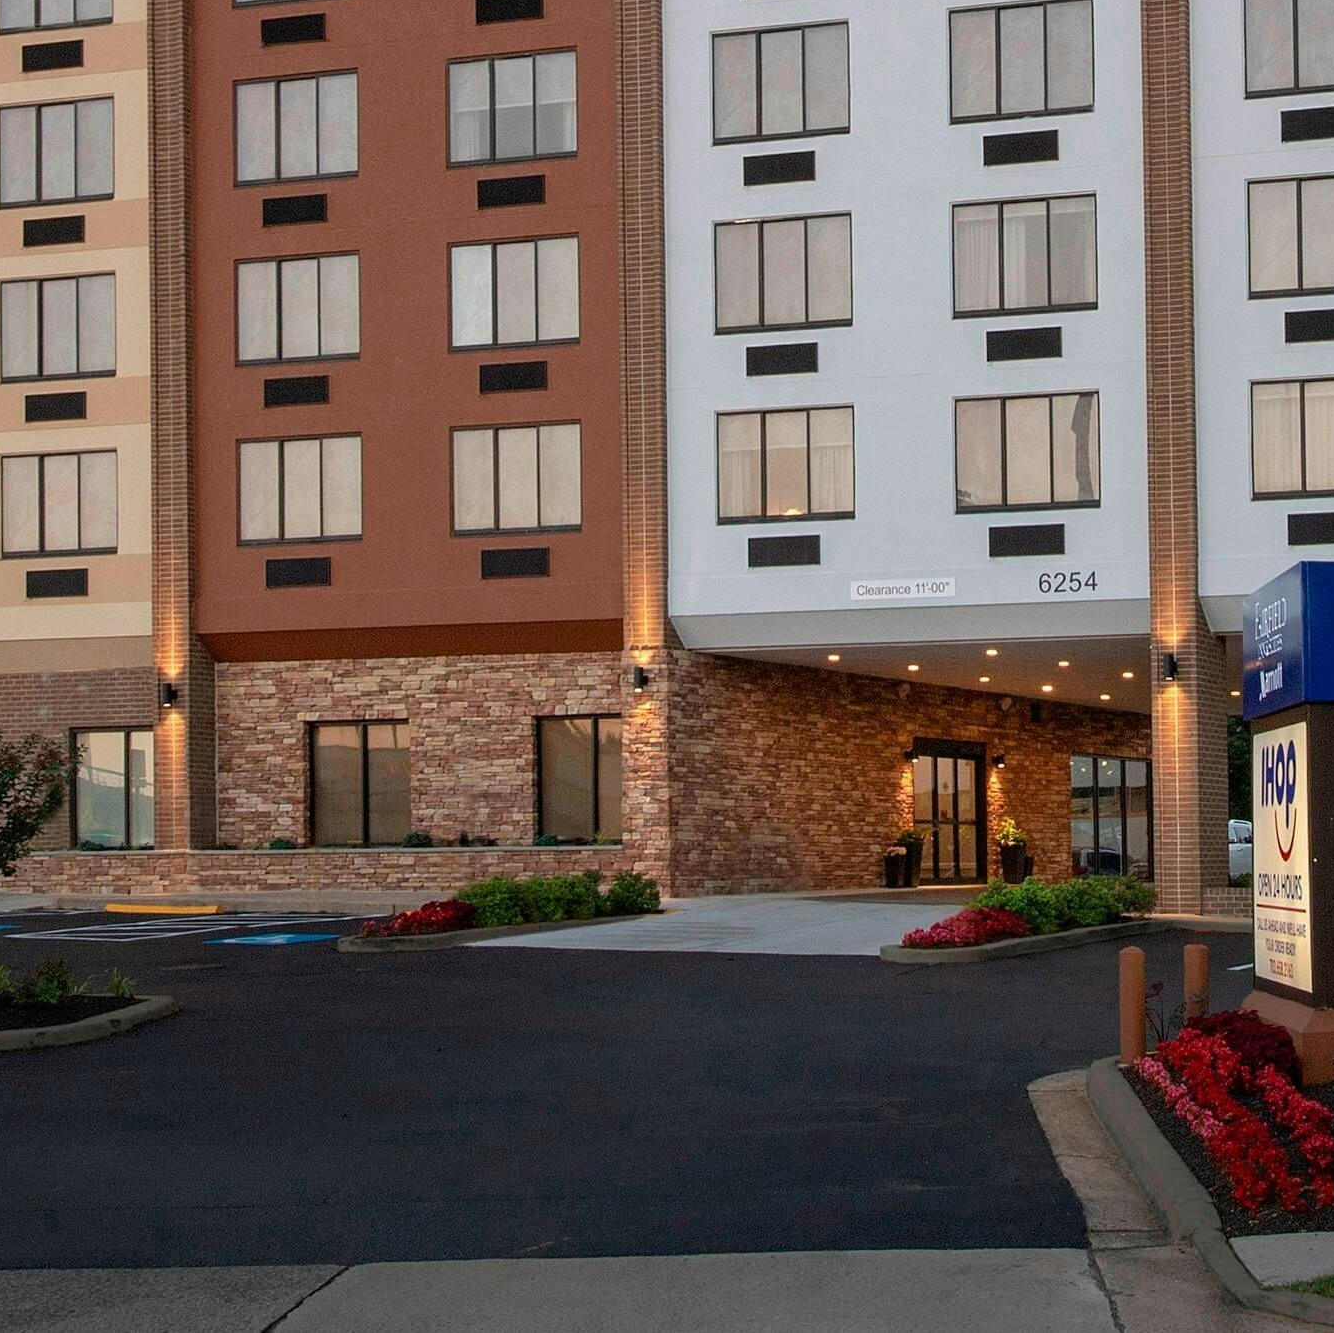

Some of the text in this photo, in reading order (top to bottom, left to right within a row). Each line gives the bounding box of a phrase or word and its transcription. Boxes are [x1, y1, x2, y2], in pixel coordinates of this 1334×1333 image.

[856, 584, 911, 597] Clearance
[1038, 570, 1099, 594] 6254
[1258, 873, 1303, 900] OPEN 24 HOURS
